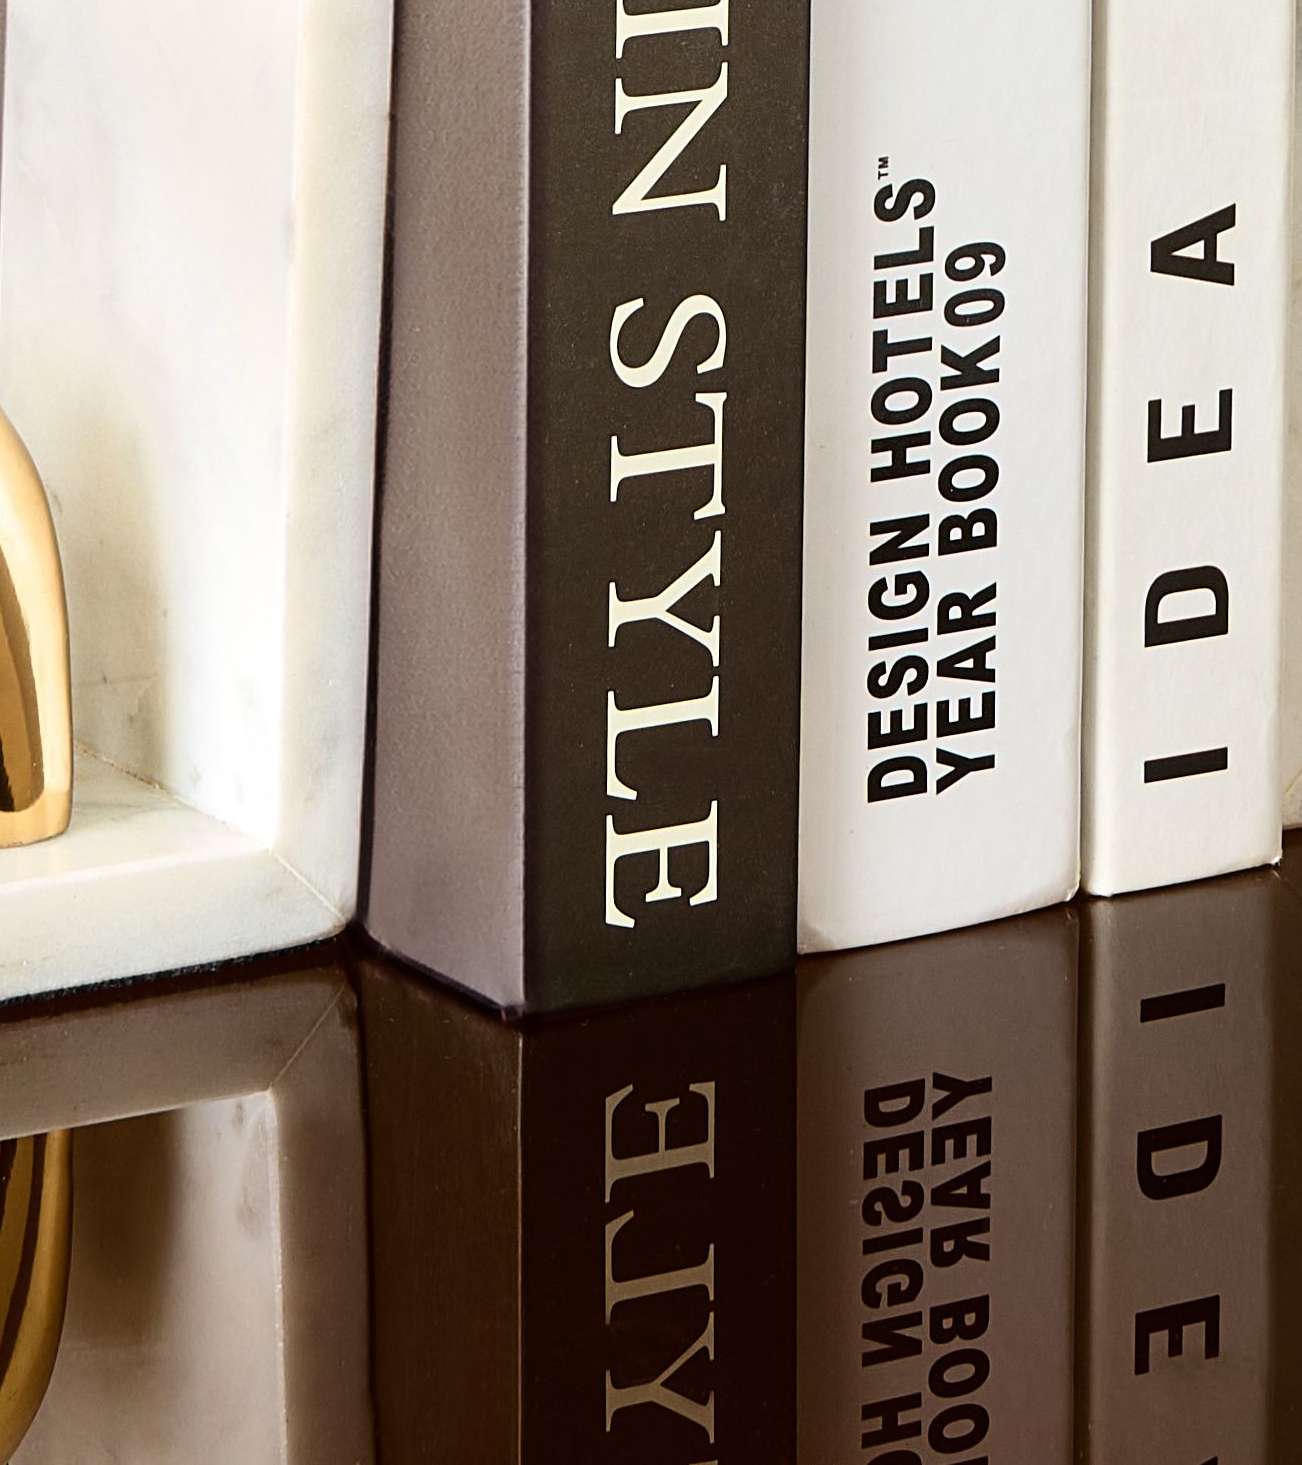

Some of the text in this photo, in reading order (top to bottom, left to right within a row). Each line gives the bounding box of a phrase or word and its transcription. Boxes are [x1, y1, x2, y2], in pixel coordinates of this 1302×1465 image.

[605, 294, 728, 929] STYLE
[866, 513, 930, 804] DESIGN
[935, 581, 997, 795] YEAR
